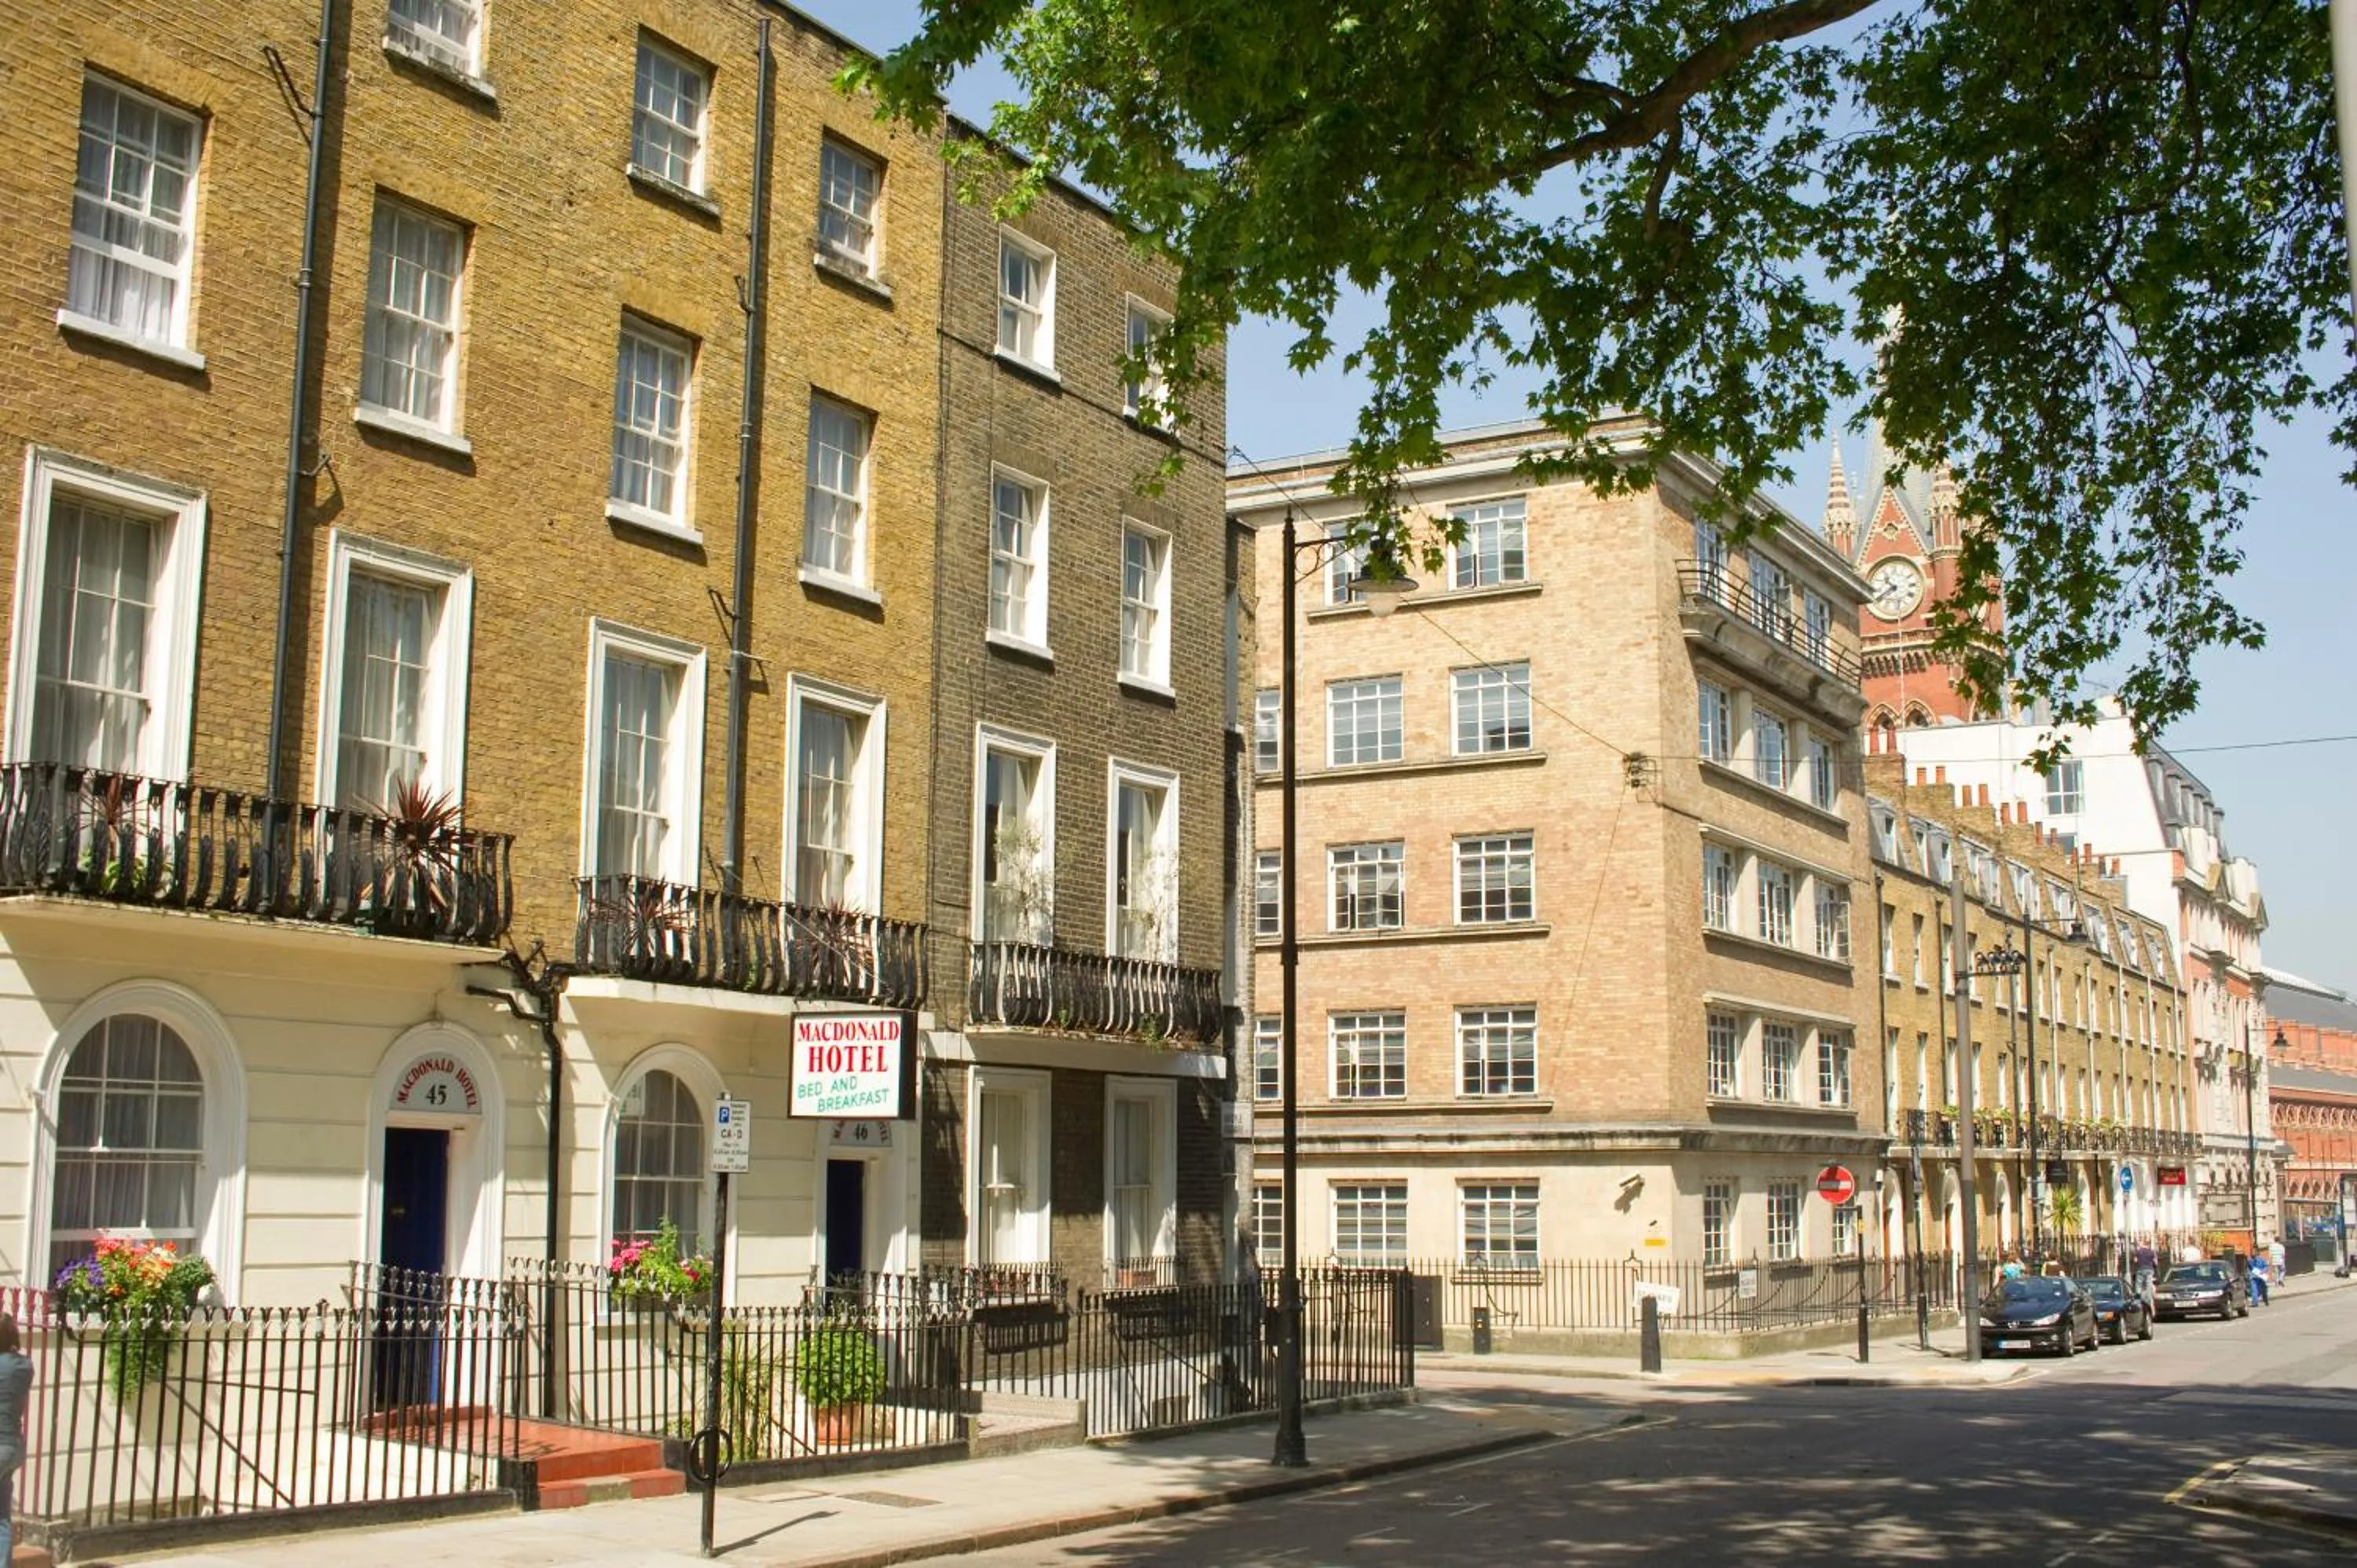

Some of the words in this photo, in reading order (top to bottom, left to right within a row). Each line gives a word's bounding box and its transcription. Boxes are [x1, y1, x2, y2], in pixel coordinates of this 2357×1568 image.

[797, 1020, 900, 1042] MACDONALD
[808, 1045, 889, 1073] HOTEL
[396, 1057, 455, 1105] MACDONALD
[455, 1068, 478, 1110] HOTEL
[425, 1084, 447, 1105] 45
[797, 1082, 823, 1099] BED
[830, 1075, 858, 1093] AND
[817, 1088, 889, 1113] BREAKFAST
[852, 1123, 868, 1141] 46
